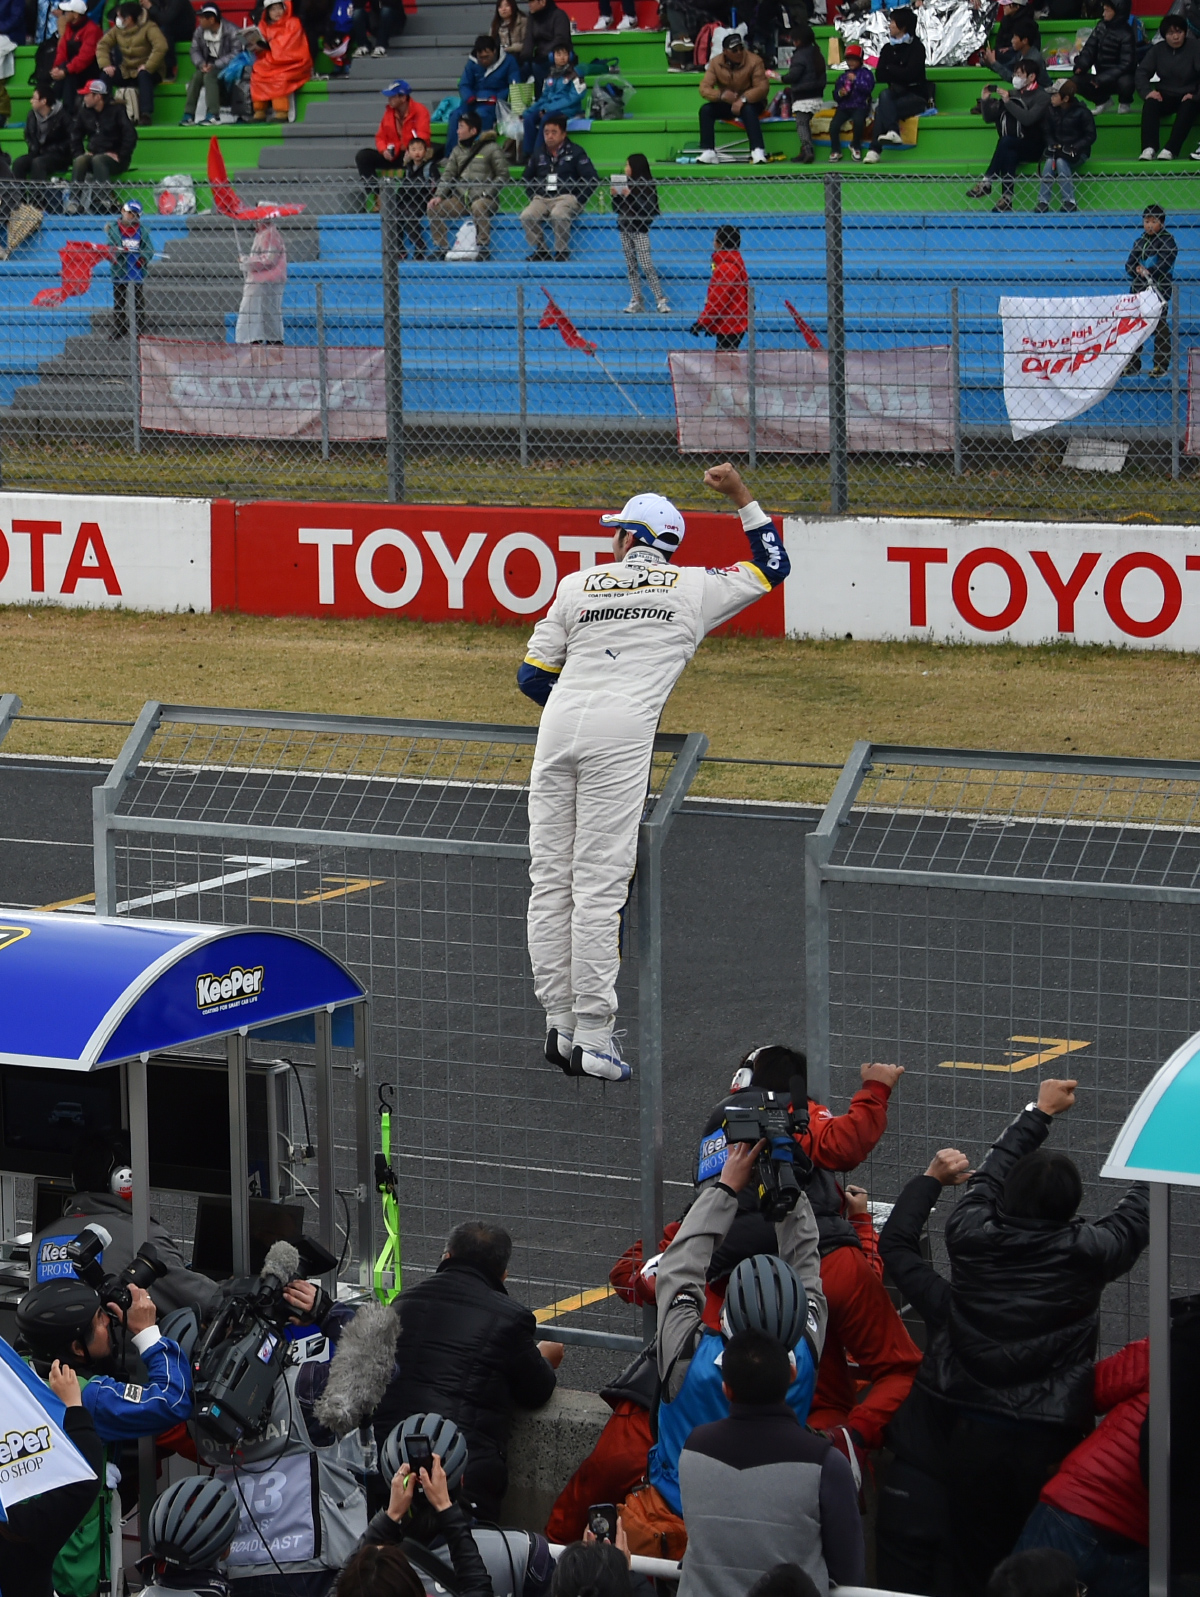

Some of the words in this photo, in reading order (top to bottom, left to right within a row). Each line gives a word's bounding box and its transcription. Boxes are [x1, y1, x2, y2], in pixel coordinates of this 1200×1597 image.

[298, 527, 615, 614] TOYOT
[887, 546, 1200, 639] TOYO
[578, 607, 676, 623] BRIDGESTONE
[197, 969, 262, 1006] KeePer
[703, 1135, 727, 1156] Kee
[701, 1157, 718, 1174] PRO
[718, 1151, 728, 1163] SH
[42, 1245, 68, 1261] Kee
[41, 1264, 61, 1276] PRO
[11, 1456, 44, 1478] SHOP
[230, 1535, 303, 1553] ROADCAST
